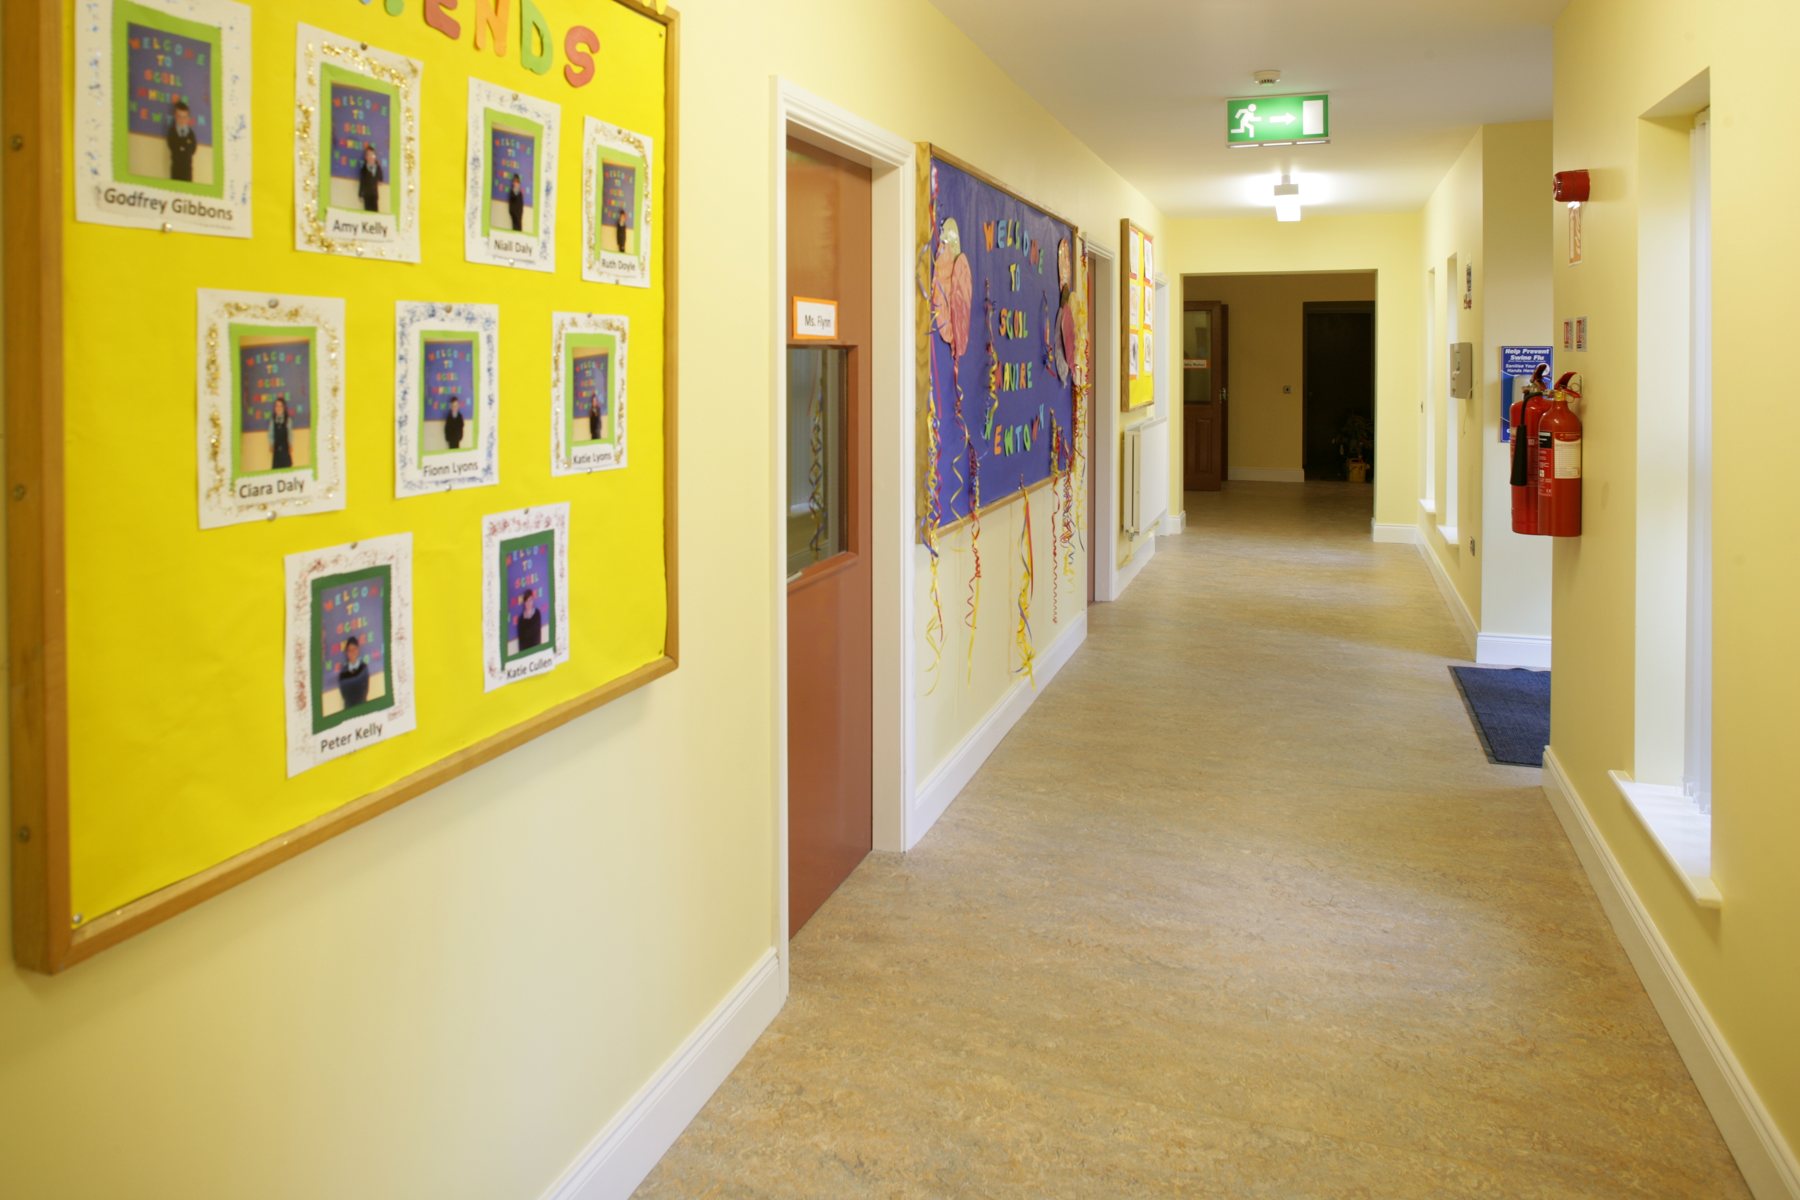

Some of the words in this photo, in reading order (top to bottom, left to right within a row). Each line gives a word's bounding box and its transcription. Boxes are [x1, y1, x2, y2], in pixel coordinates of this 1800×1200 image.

[104, 188, 167, 214] Godfrey
[172, 198, 233, 221] Gibbons
[333, 220, 358, 235] Amy
[362, 222, 388, 236] Kelly
[494, 239, 513, 252] Niall
[515, 242, 532, 256] Daly
[983, 219, 1044, 274] WELCOME
[1009, 263, 1020, 292] TO
[999, 308, 1028, 340] SCOIL
[593, 453, 611, 464] Lyons
[424, 464, 450, 477] Fionn
[452, 461, 478, 476] Lyons
[239, 483, 273, 499] Ciara
[277, 479, 304, 493] Daly
[506, 666, 527, 680] Katie
[529, 660, 552, 673] Cullen
[320, 733, 351, 753] Peter
[355, 723, 383, 741] Kelly
